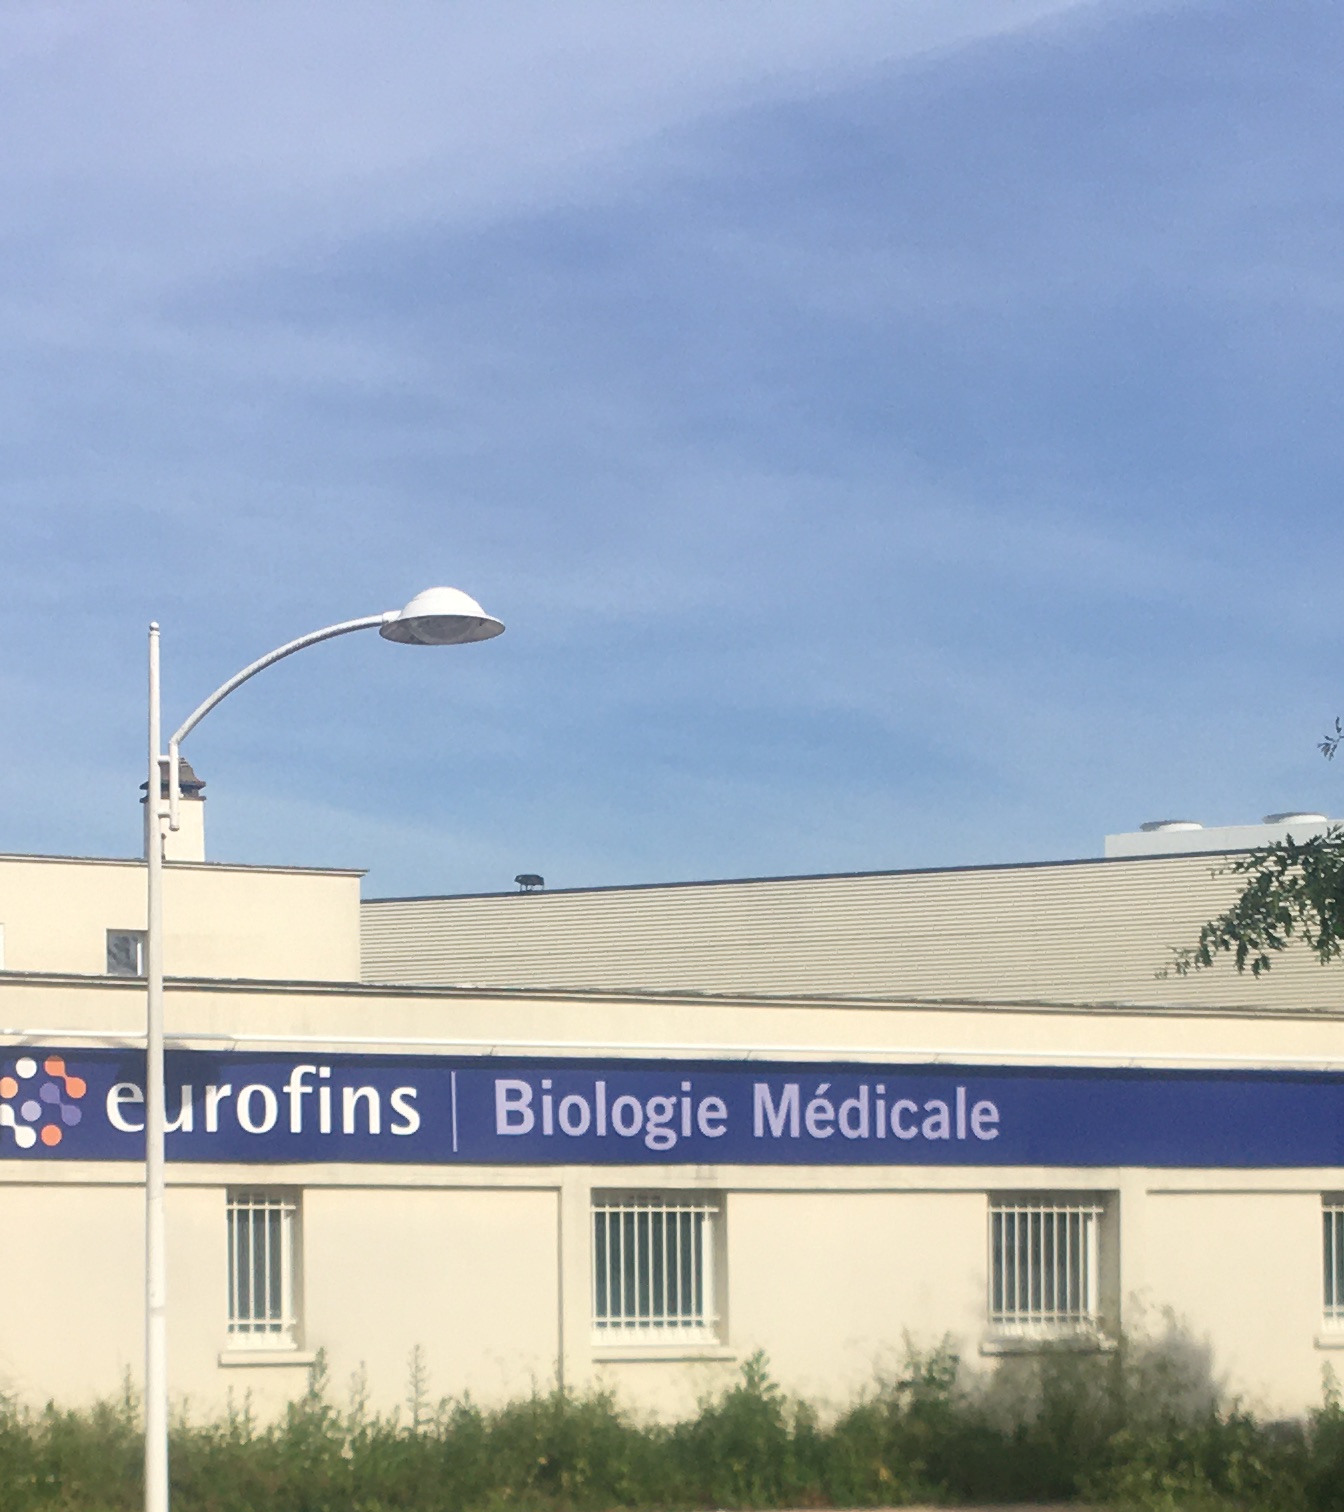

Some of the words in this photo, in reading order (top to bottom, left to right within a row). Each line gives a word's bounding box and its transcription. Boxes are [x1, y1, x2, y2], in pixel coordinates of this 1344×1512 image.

[105, 1066, 420, 1134] eurofins
[495, 1079, 728, 1150] Biologie
[753, 1083, 1000, 1140] Médicale
